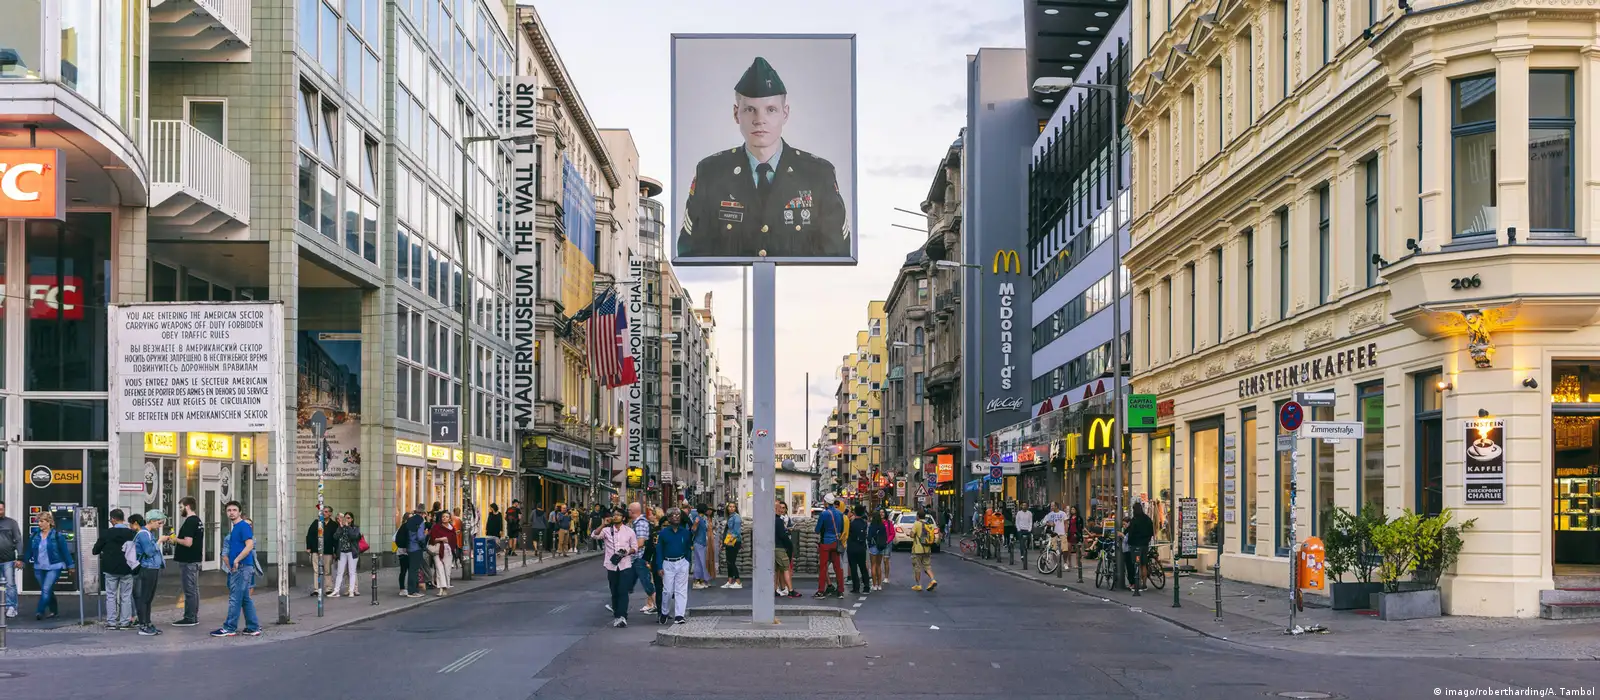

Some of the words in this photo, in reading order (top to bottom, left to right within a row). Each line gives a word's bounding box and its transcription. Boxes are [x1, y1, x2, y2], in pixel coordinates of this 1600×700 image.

[516, 83, 534, 128] MUR
[515, 140, 533, 153] L
[515, 164, 533, 215] WALL
[515, 221, 533, 254] THE
[1451, 273, 1481, 289] 206
[127, 311, 139, 320] YOU
[143, 311, 154, 320] ARE
[158, 311, 187, 320] ENTERING
[191, 311, 200, 320] THE
[204, 311, 236, 320] AMERICAN
[240, 311, 263, 320] SECTOR
[126, 321, 158, 329] CARRYING
[161, 321, 192, 329] WEAPONS
[195, 321, 206, 329] OFF
[210, 321, 225, 329] DUTY
[228, 321, 263, 329] FORBIDDEN
[162, 331, 178, 339] OBEY
[182, 331, 206, 339] TRAFFIC
[210, 331, 229, 339] RULES
[999, 283, 1015, 390] McDonald's
[131, 345, 140, 353] ВЫ
[179, 344, 183, 352] В
[186, 343, 237, 352] АМЕРИКАНСКИЙ
[240, 344, 262, 352] СЕКТОР
[515, 265, 533, 421] MAUERMUSEUM
[204, 354, 208, 362] В
[250, 353, 268, 362] ВРЕМЯ
[181, 363, 219, 373] ДОРОЖНЫМ
[223, 363, 257, 373] ПРАВИЛАМ
[1239, 365, 1298, 398] EINSTEIN
[1312, 343, 1377, 380] KAFFEE
[125, 377, 142, 387] VOUS
[146, 377, 168, 387] ENTREZ
[172, 377, 188, 387] DANS
[192, 377, 197, 387] LE
[201, 377, 229, 387] SECTEUR
[148, 388, 155, 396] DE
[156, 388, 174, 396] PORTER
[176, 388, 186, 396] DES
[187, 388, 205, 396] ARMES
[206, 388, 213, 396] EN
[215, 387, 236, 395] DEHORS
[238, 387, 245, 395] DU
[247, 387, 268, 395] SERVICE
[167, 397, 180, 406] AUX
[210, 397, 216, 406] DE
[221, 397, 260, 406] CIRCULATION
[125, 412, 134, 420] SIE
[138, 412, 168, 420] BETRETEN
[172, 412, 183, 420] DEN
[186, 410, 241, 419] AMERIKANISCHEN
[244, 410, 267, 418] SEKTOR
[629, 403, 641, 424] AM
[1311, 425, 1354, 435] Zimmerstraße
[629, 428, 641, 462] HAUS
